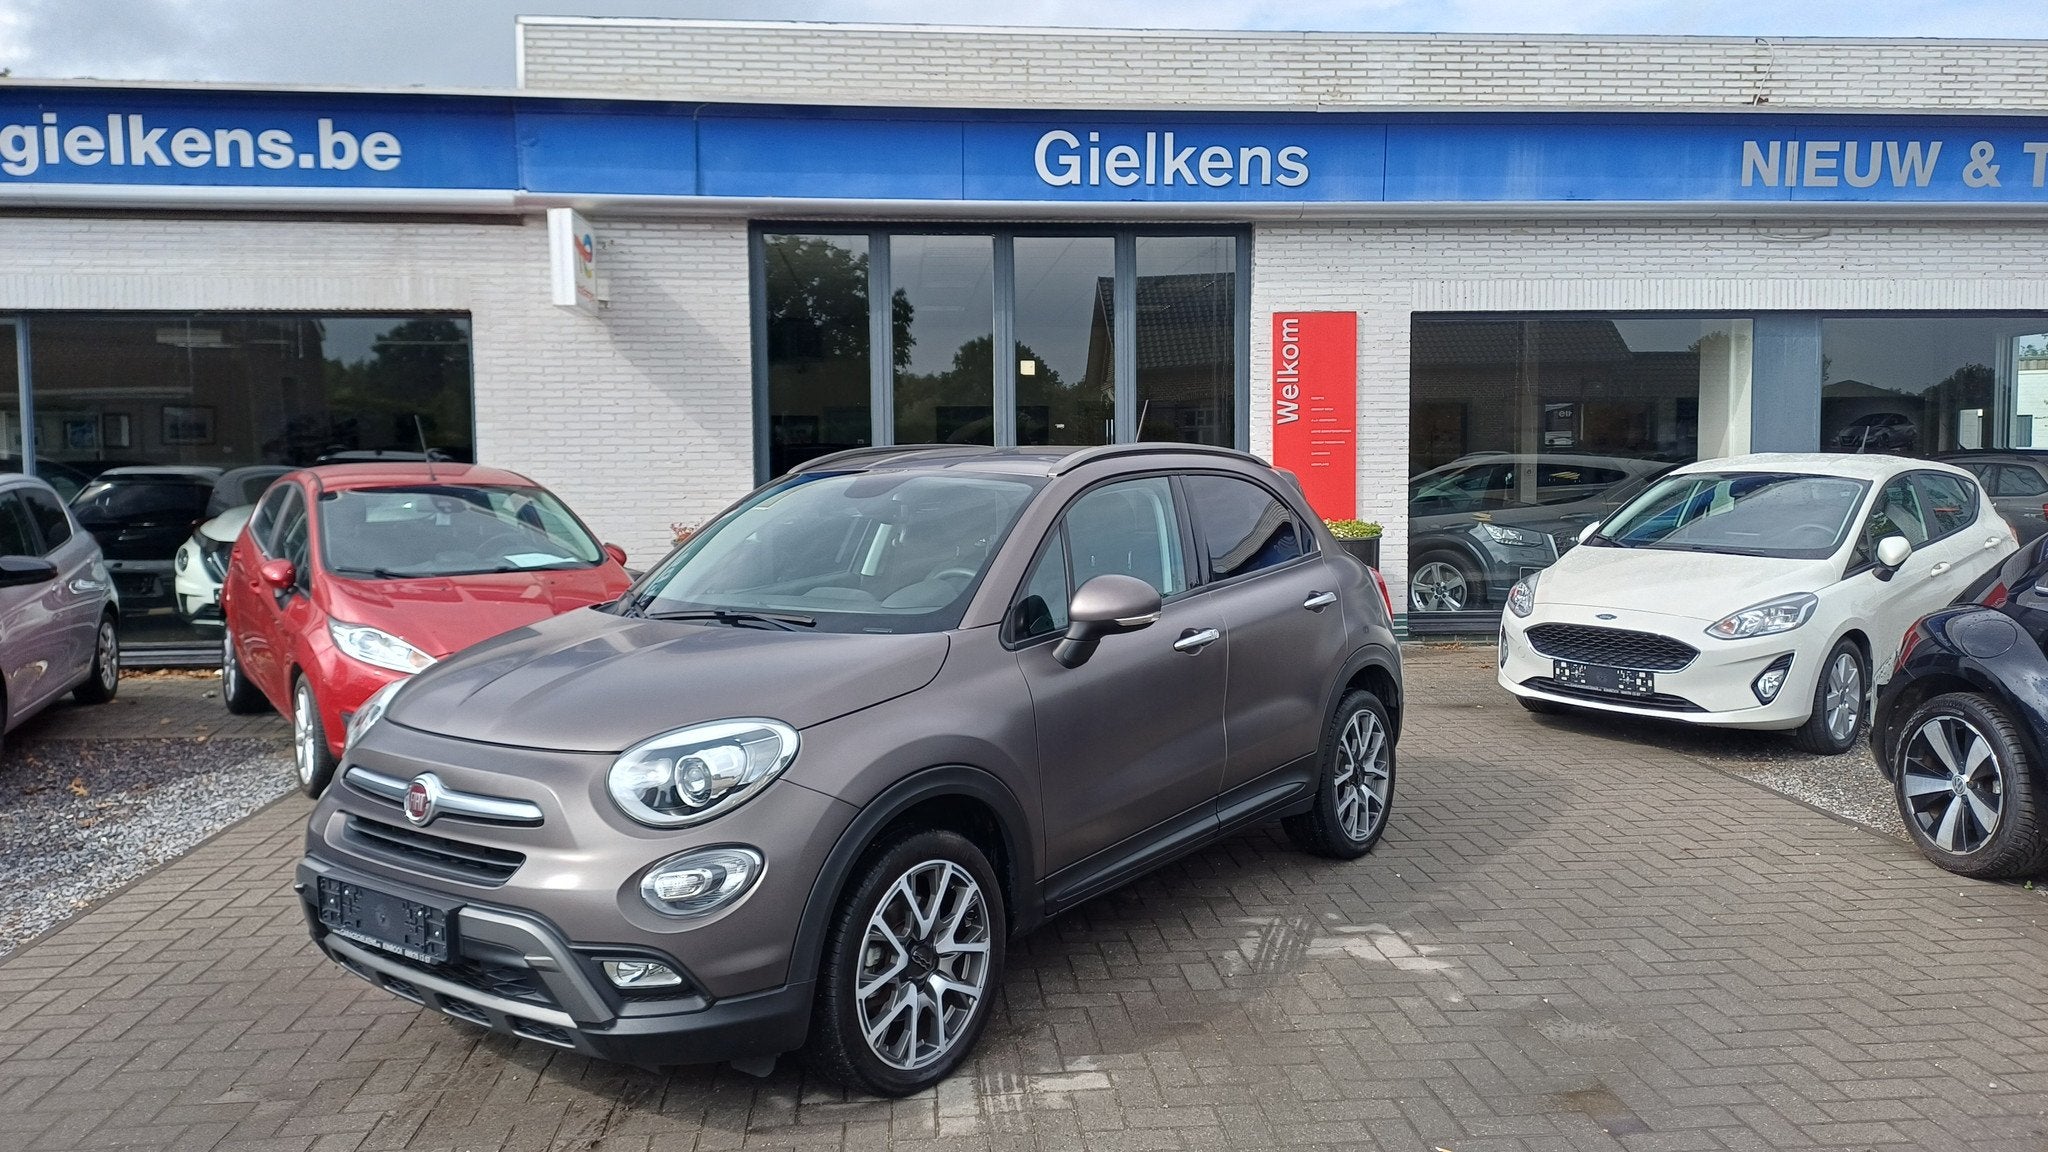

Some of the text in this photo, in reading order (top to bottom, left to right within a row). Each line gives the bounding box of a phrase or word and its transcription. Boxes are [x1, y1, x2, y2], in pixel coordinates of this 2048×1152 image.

[0, 112, 401, 177] gielkens.be
[1034, 129, 1309, 187] Gielkens
[1741, 140, 1943, 188] NIEUW
[1962, 140, 2002, 188] &
[1276, 318, 1300, 425] Welkom
[411, 791, 426, 812] FIAT
